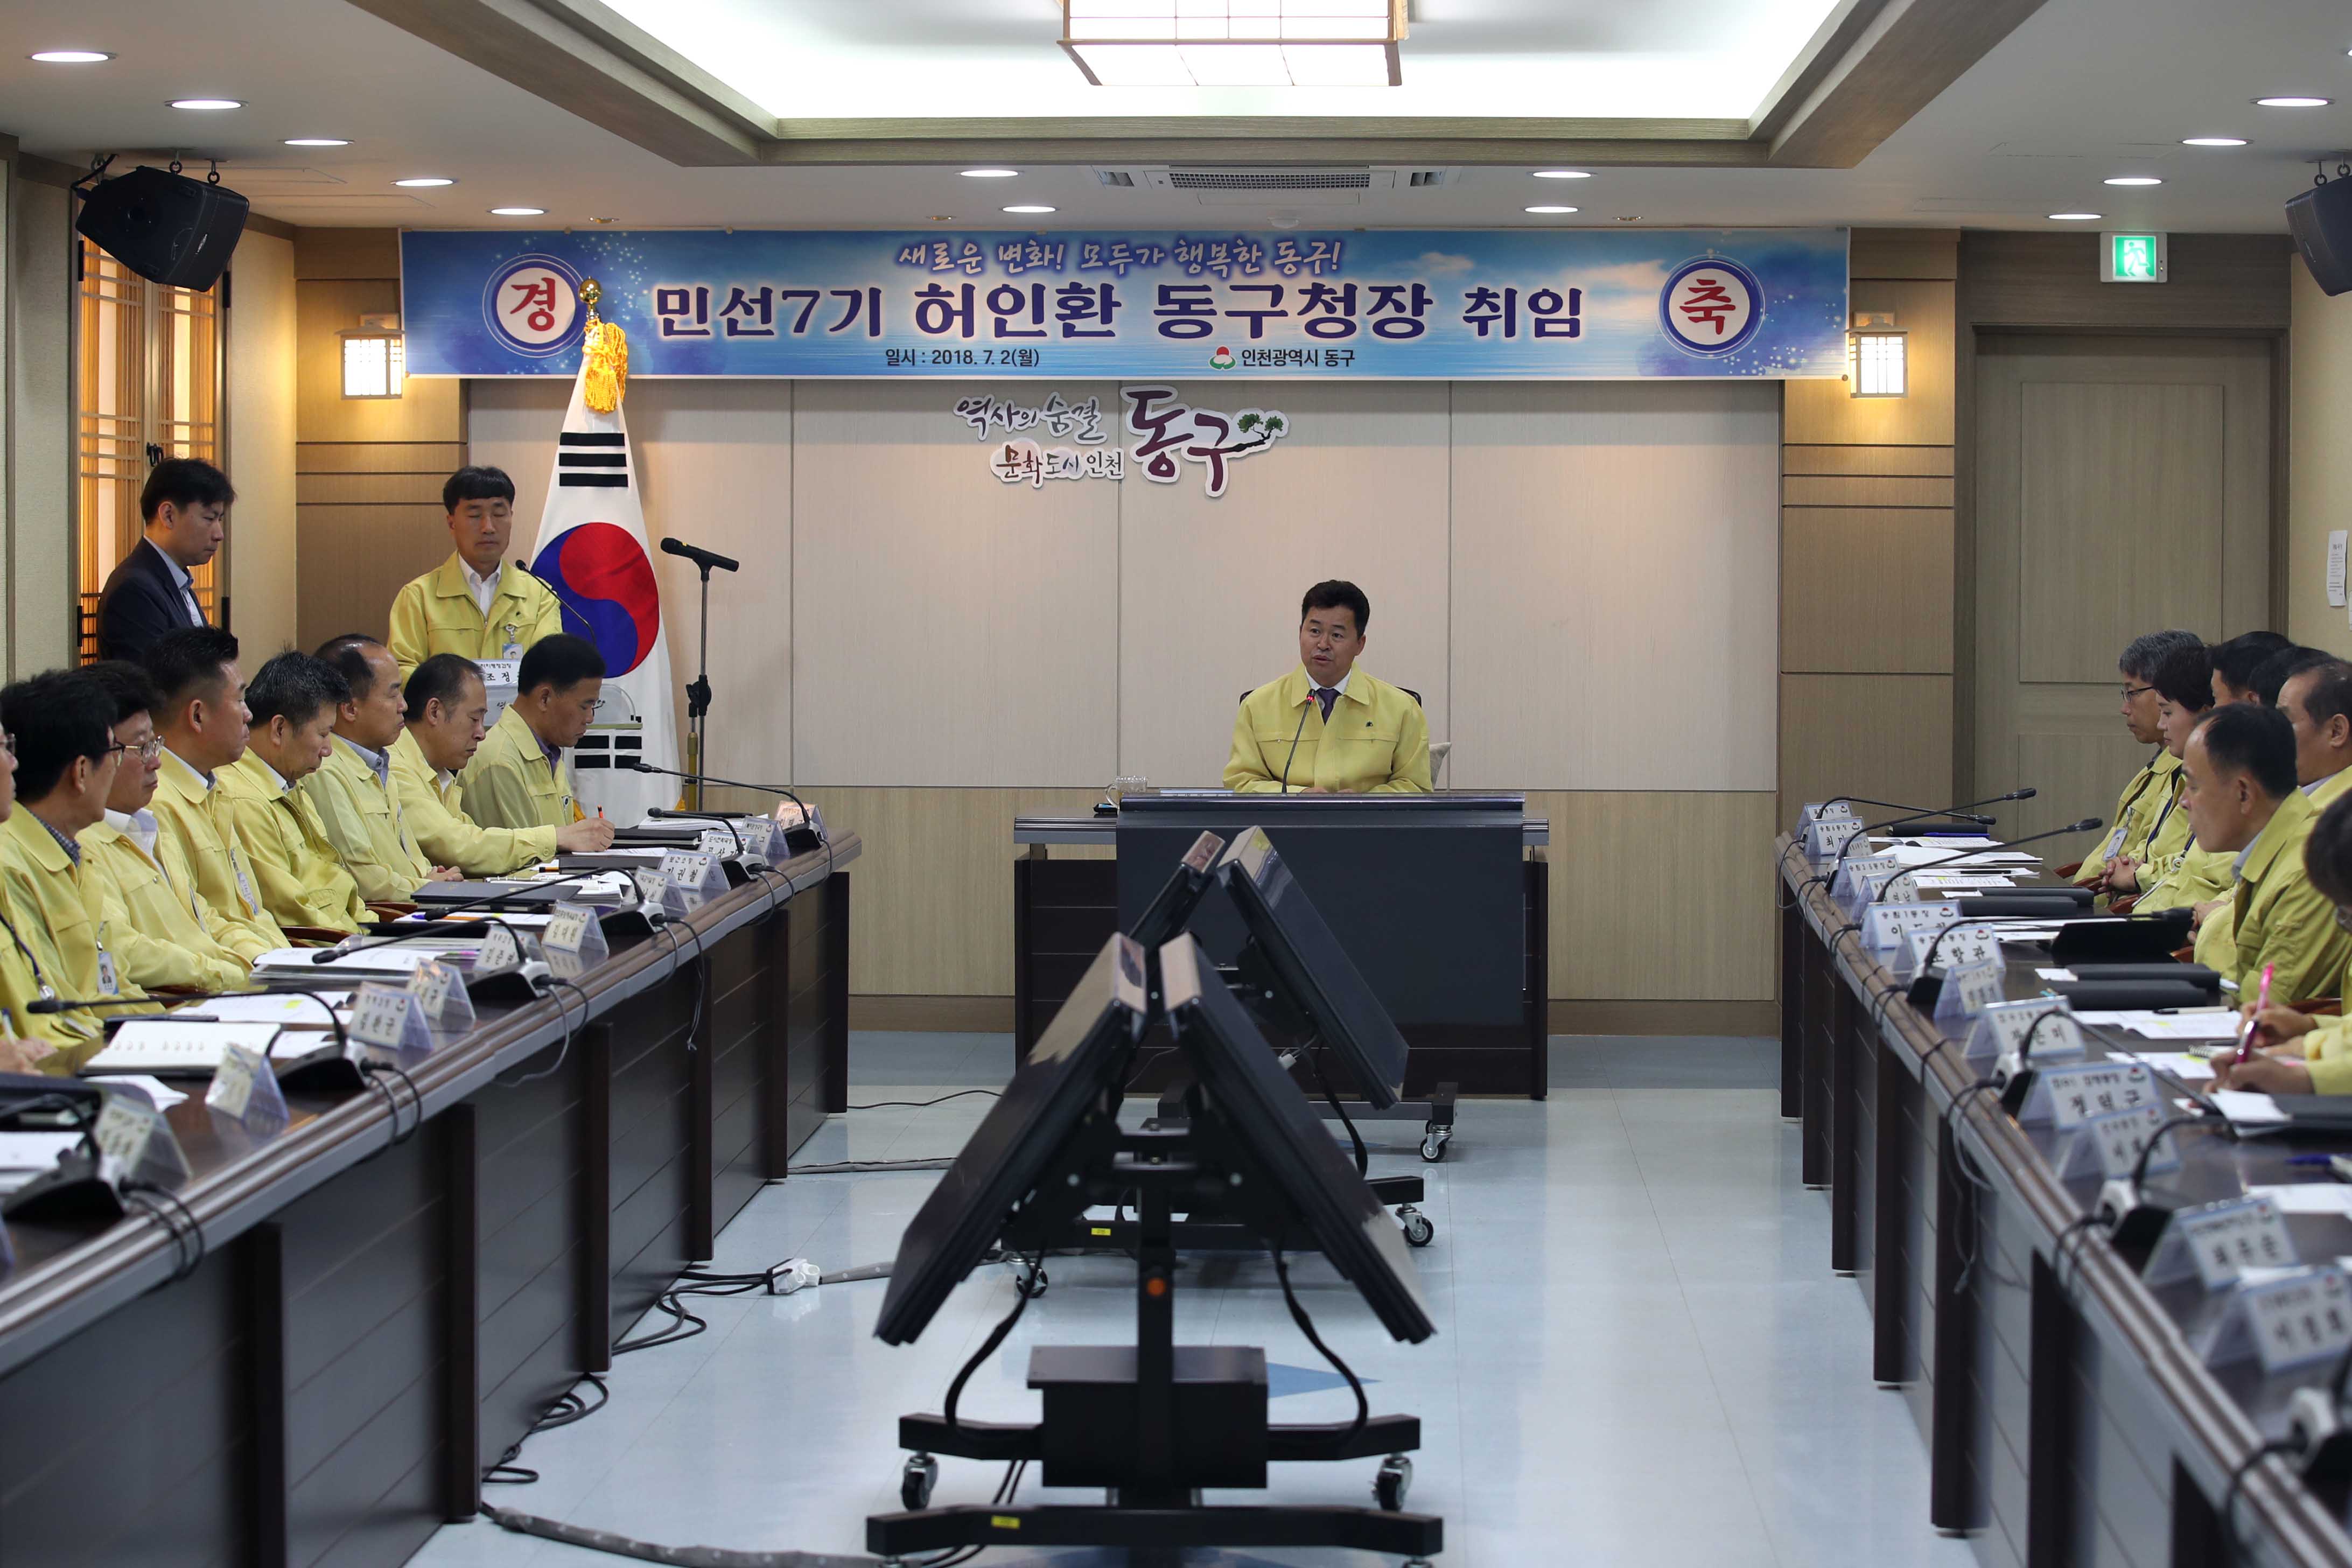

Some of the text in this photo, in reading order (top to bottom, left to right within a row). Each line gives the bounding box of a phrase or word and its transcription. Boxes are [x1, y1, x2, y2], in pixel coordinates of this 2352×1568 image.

[899, 239, 1341, 278] 새로운 변화! 모두가 행복한 동구!
[509, 276, 558, 331] 경
[656, 281, 1583, 339] 민선7기 허인환 동구청장 취임
[1678, 277, 1737, 335] 축
[885, 348, 916, 366] 일시
[931, 349, 978, 365] 2018.
[983, 350, 995, 365] 7.
[1000, 348, 1040, 367] 2(월)
[1241, 348, 1356, 367] 인천광역시 동구
[957, 395, 1105, 440] 역사의 숨결
[1126, 390, 1230, 492] 동구
[1086, 451, 1123, 477] 인천
